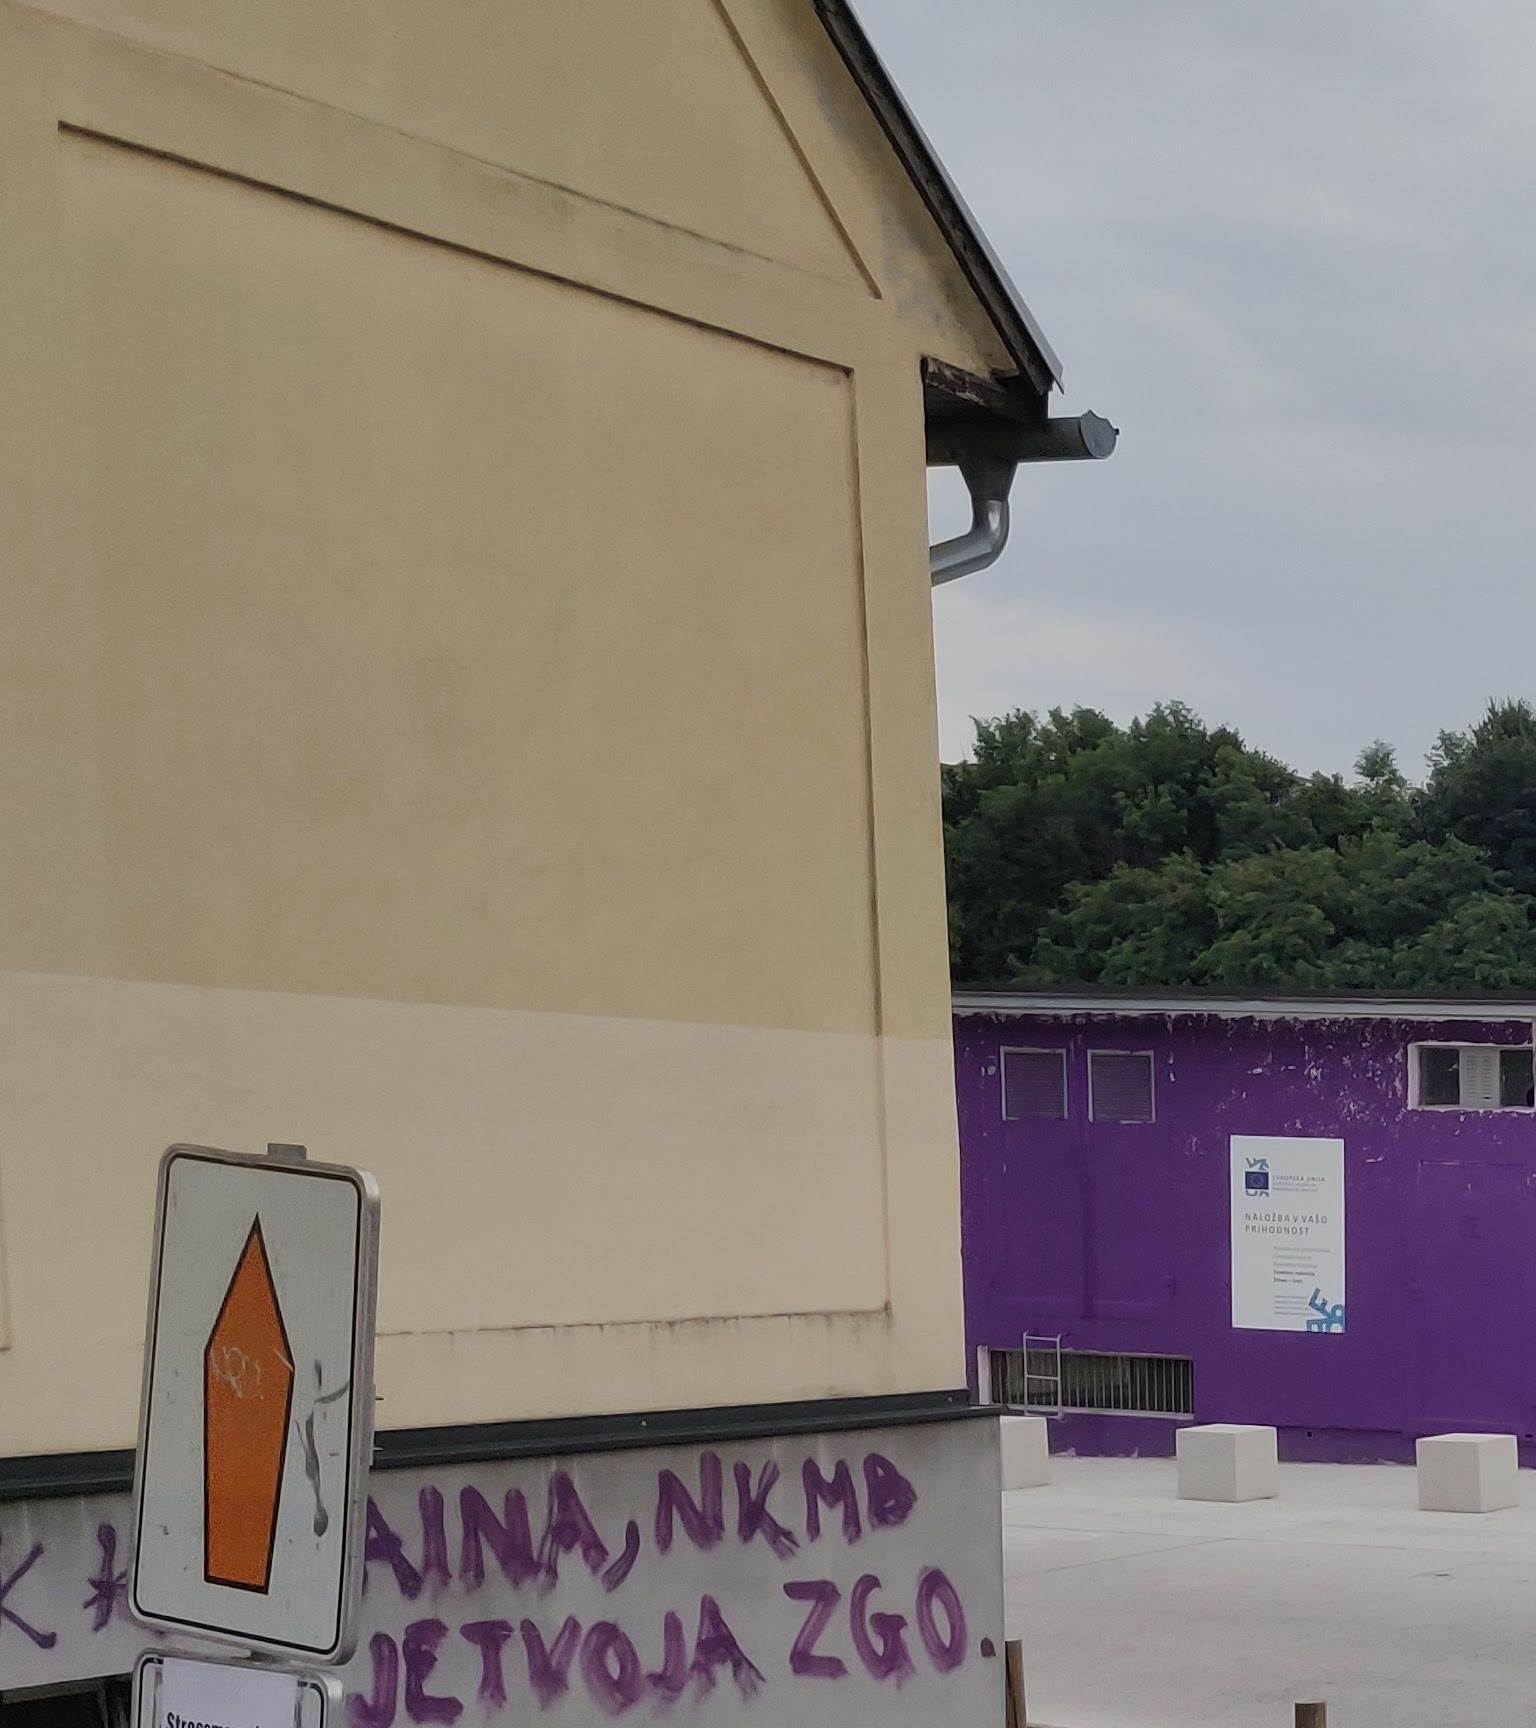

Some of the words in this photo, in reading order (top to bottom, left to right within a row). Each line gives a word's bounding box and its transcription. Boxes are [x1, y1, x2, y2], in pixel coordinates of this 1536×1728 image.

[1245, 1212, 1290, 1222] NALOŽBA
[1293, 1215, 1299, 1223] V
[1301, 1213, 1328, 1224] VAŠO
[1245, 1224, 1309, 1235] PRIHODNOST
